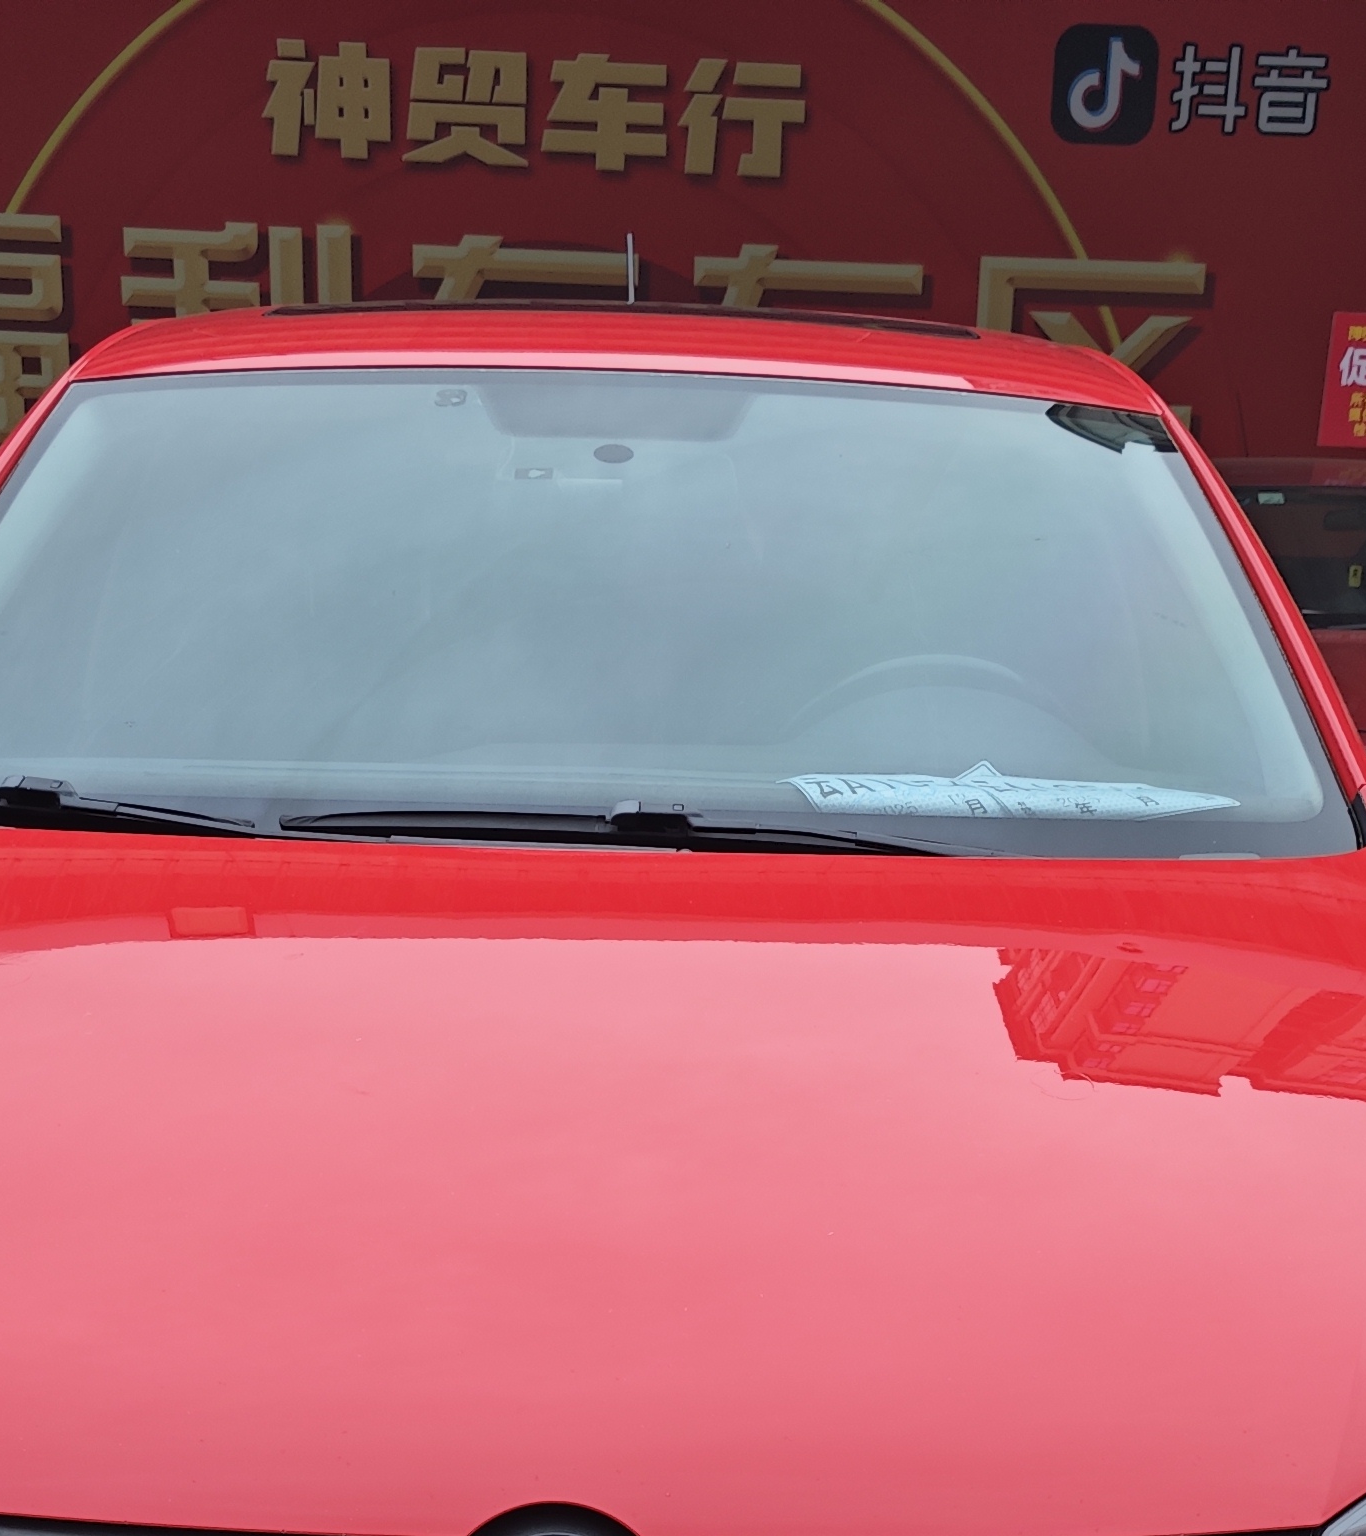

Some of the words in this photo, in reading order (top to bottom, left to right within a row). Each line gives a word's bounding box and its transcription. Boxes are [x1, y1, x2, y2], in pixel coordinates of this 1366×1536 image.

[262, 38, 806, 178] 神贸车行
[1168, 44, 1329, 134] 抖音
